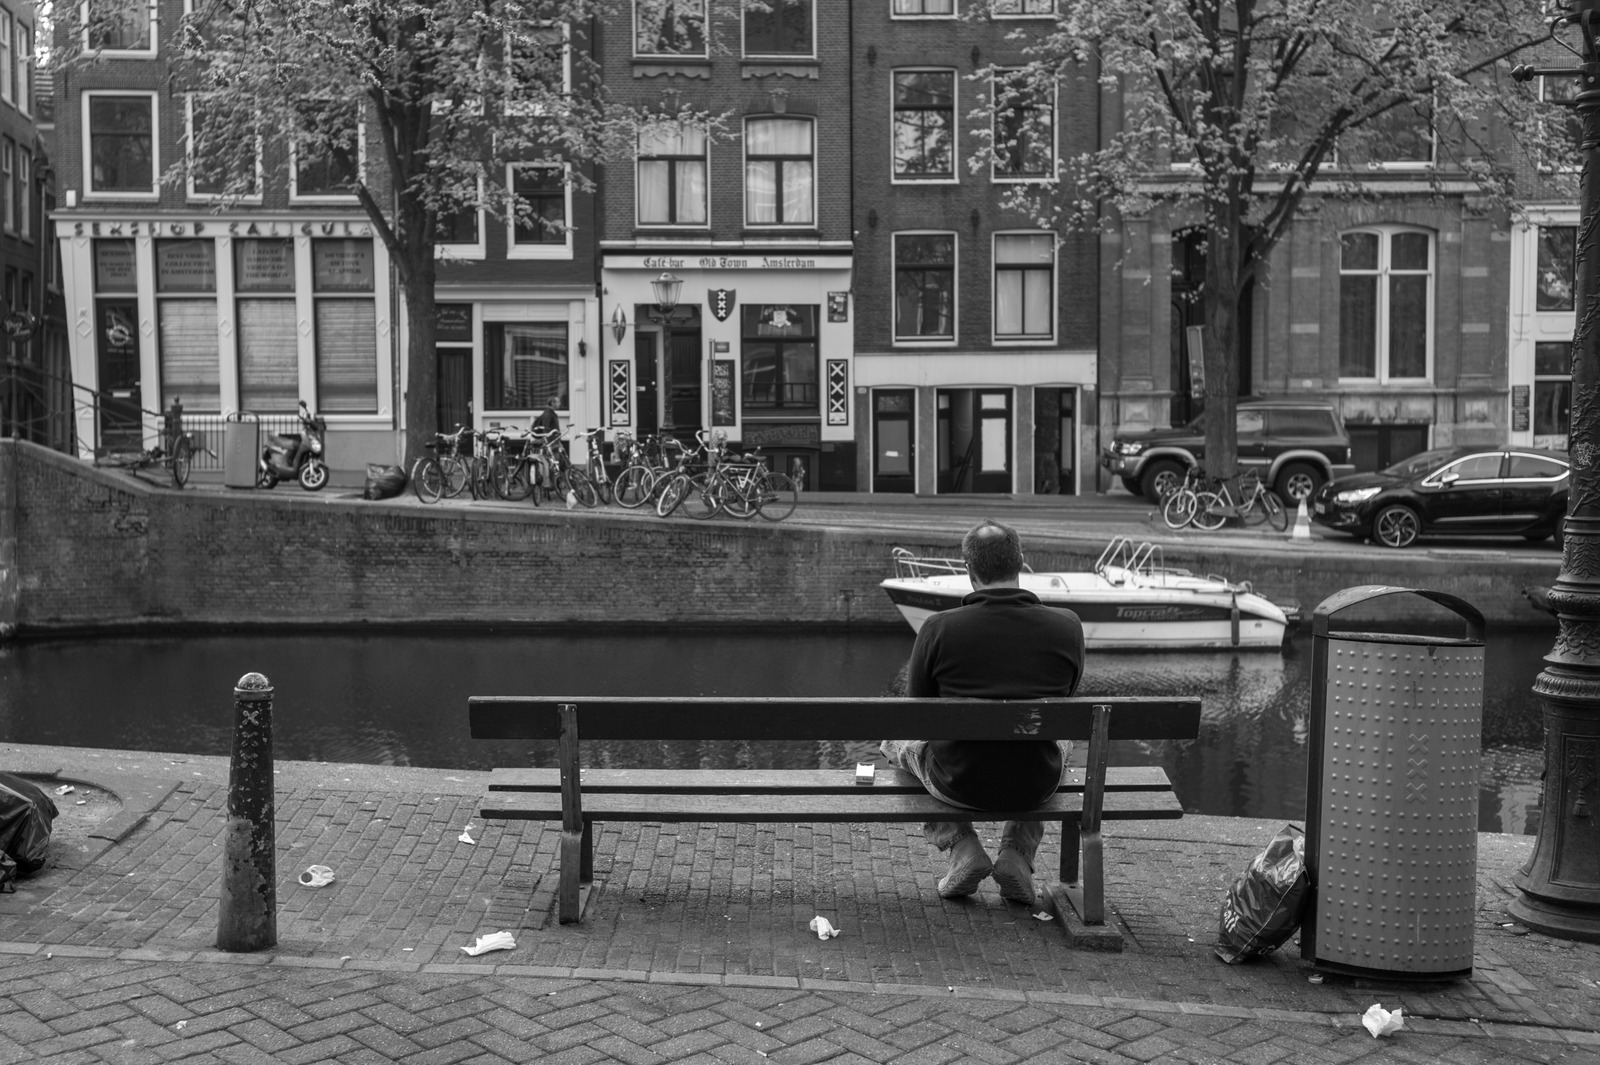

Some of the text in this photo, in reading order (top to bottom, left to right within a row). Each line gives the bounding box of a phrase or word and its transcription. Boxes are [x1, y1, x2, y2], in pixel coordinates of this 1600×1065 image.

[699, 256, 717, 268] Old
[719, 256, 748, 268] Town
[761, 256, 815, 268] Amsterdam
[1116, 605, 1181, 620] Topcraft
